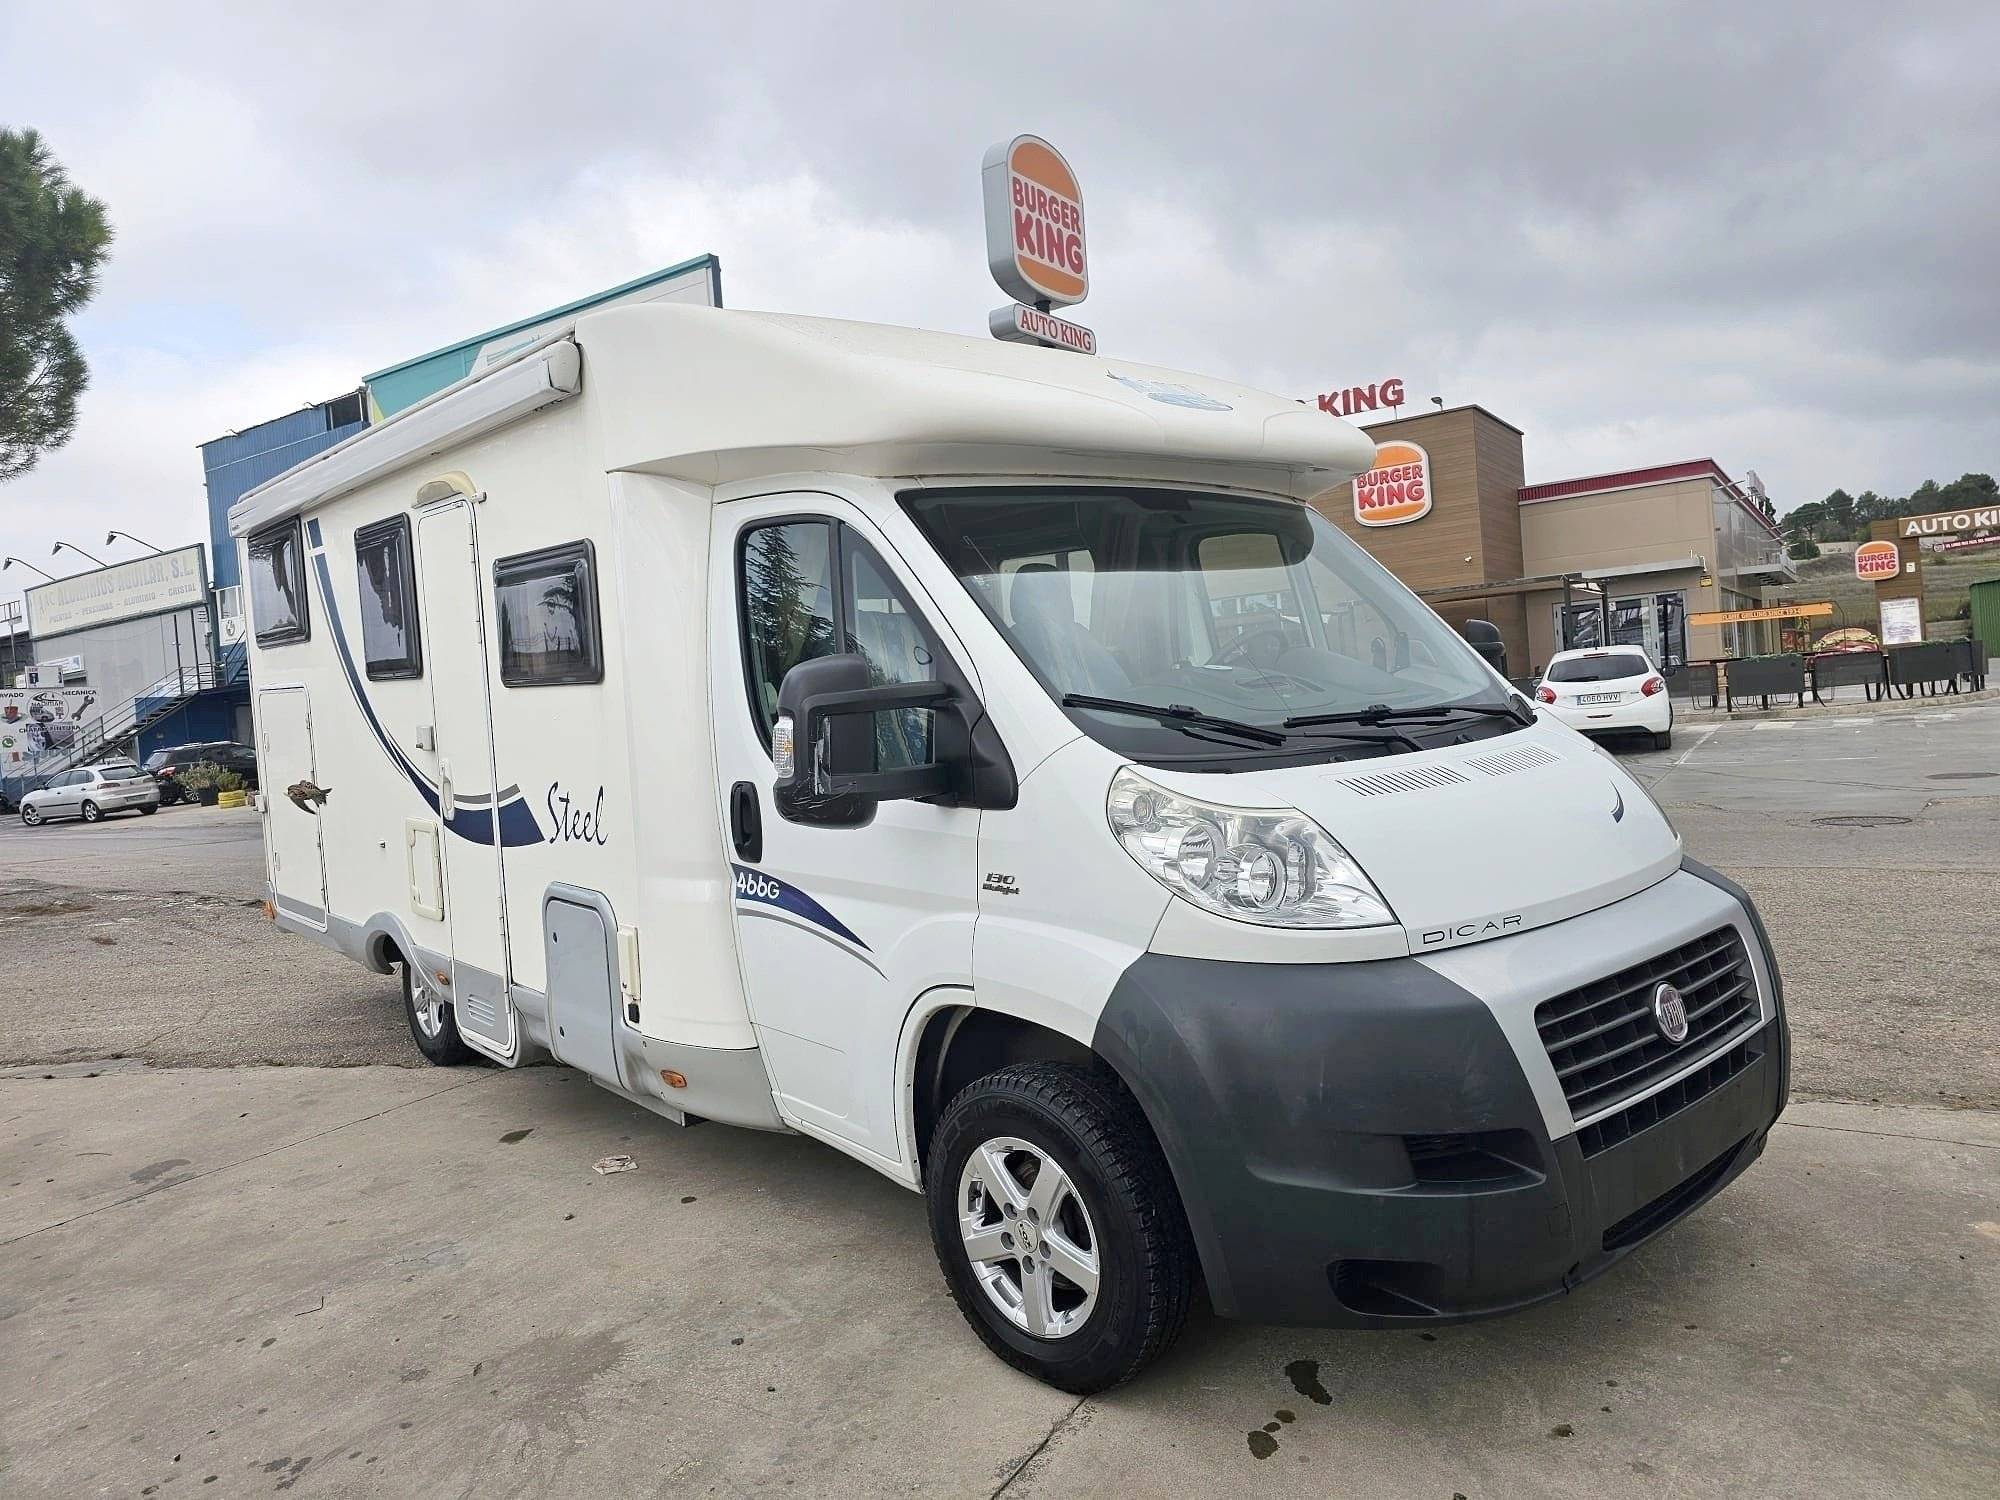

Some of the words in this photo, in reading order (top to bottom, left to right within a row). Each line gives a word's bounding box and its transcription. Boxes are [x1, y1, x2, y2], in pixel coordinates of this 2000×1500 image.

[1012, 177, 1081, 234] BURGER
[1014, 208, 1083, 274] KING
[1020, 310, 1058, 339] AUTO
[1060, 323, 1091, 351] KING
[1318, 378, 1405, 417] KING
[1357, 464, 1423, 489] BURGER
[1358, 480, 1425, 510] KING
[1905, 514, 1971, 536] AUTO
[1974, 509, 2000, 527] KI
[1857, 552, 1896, 563] BURGER
[1858, 560, 1896, 573] KING
[168, 585, 196, 597] CRISTAL
[547, 781, 608, 846] Steel
[737, 871, 780, 899] 466G
[986, 872, 1015, 885] 130
[1422, 914, 1522, 945] DICAR
